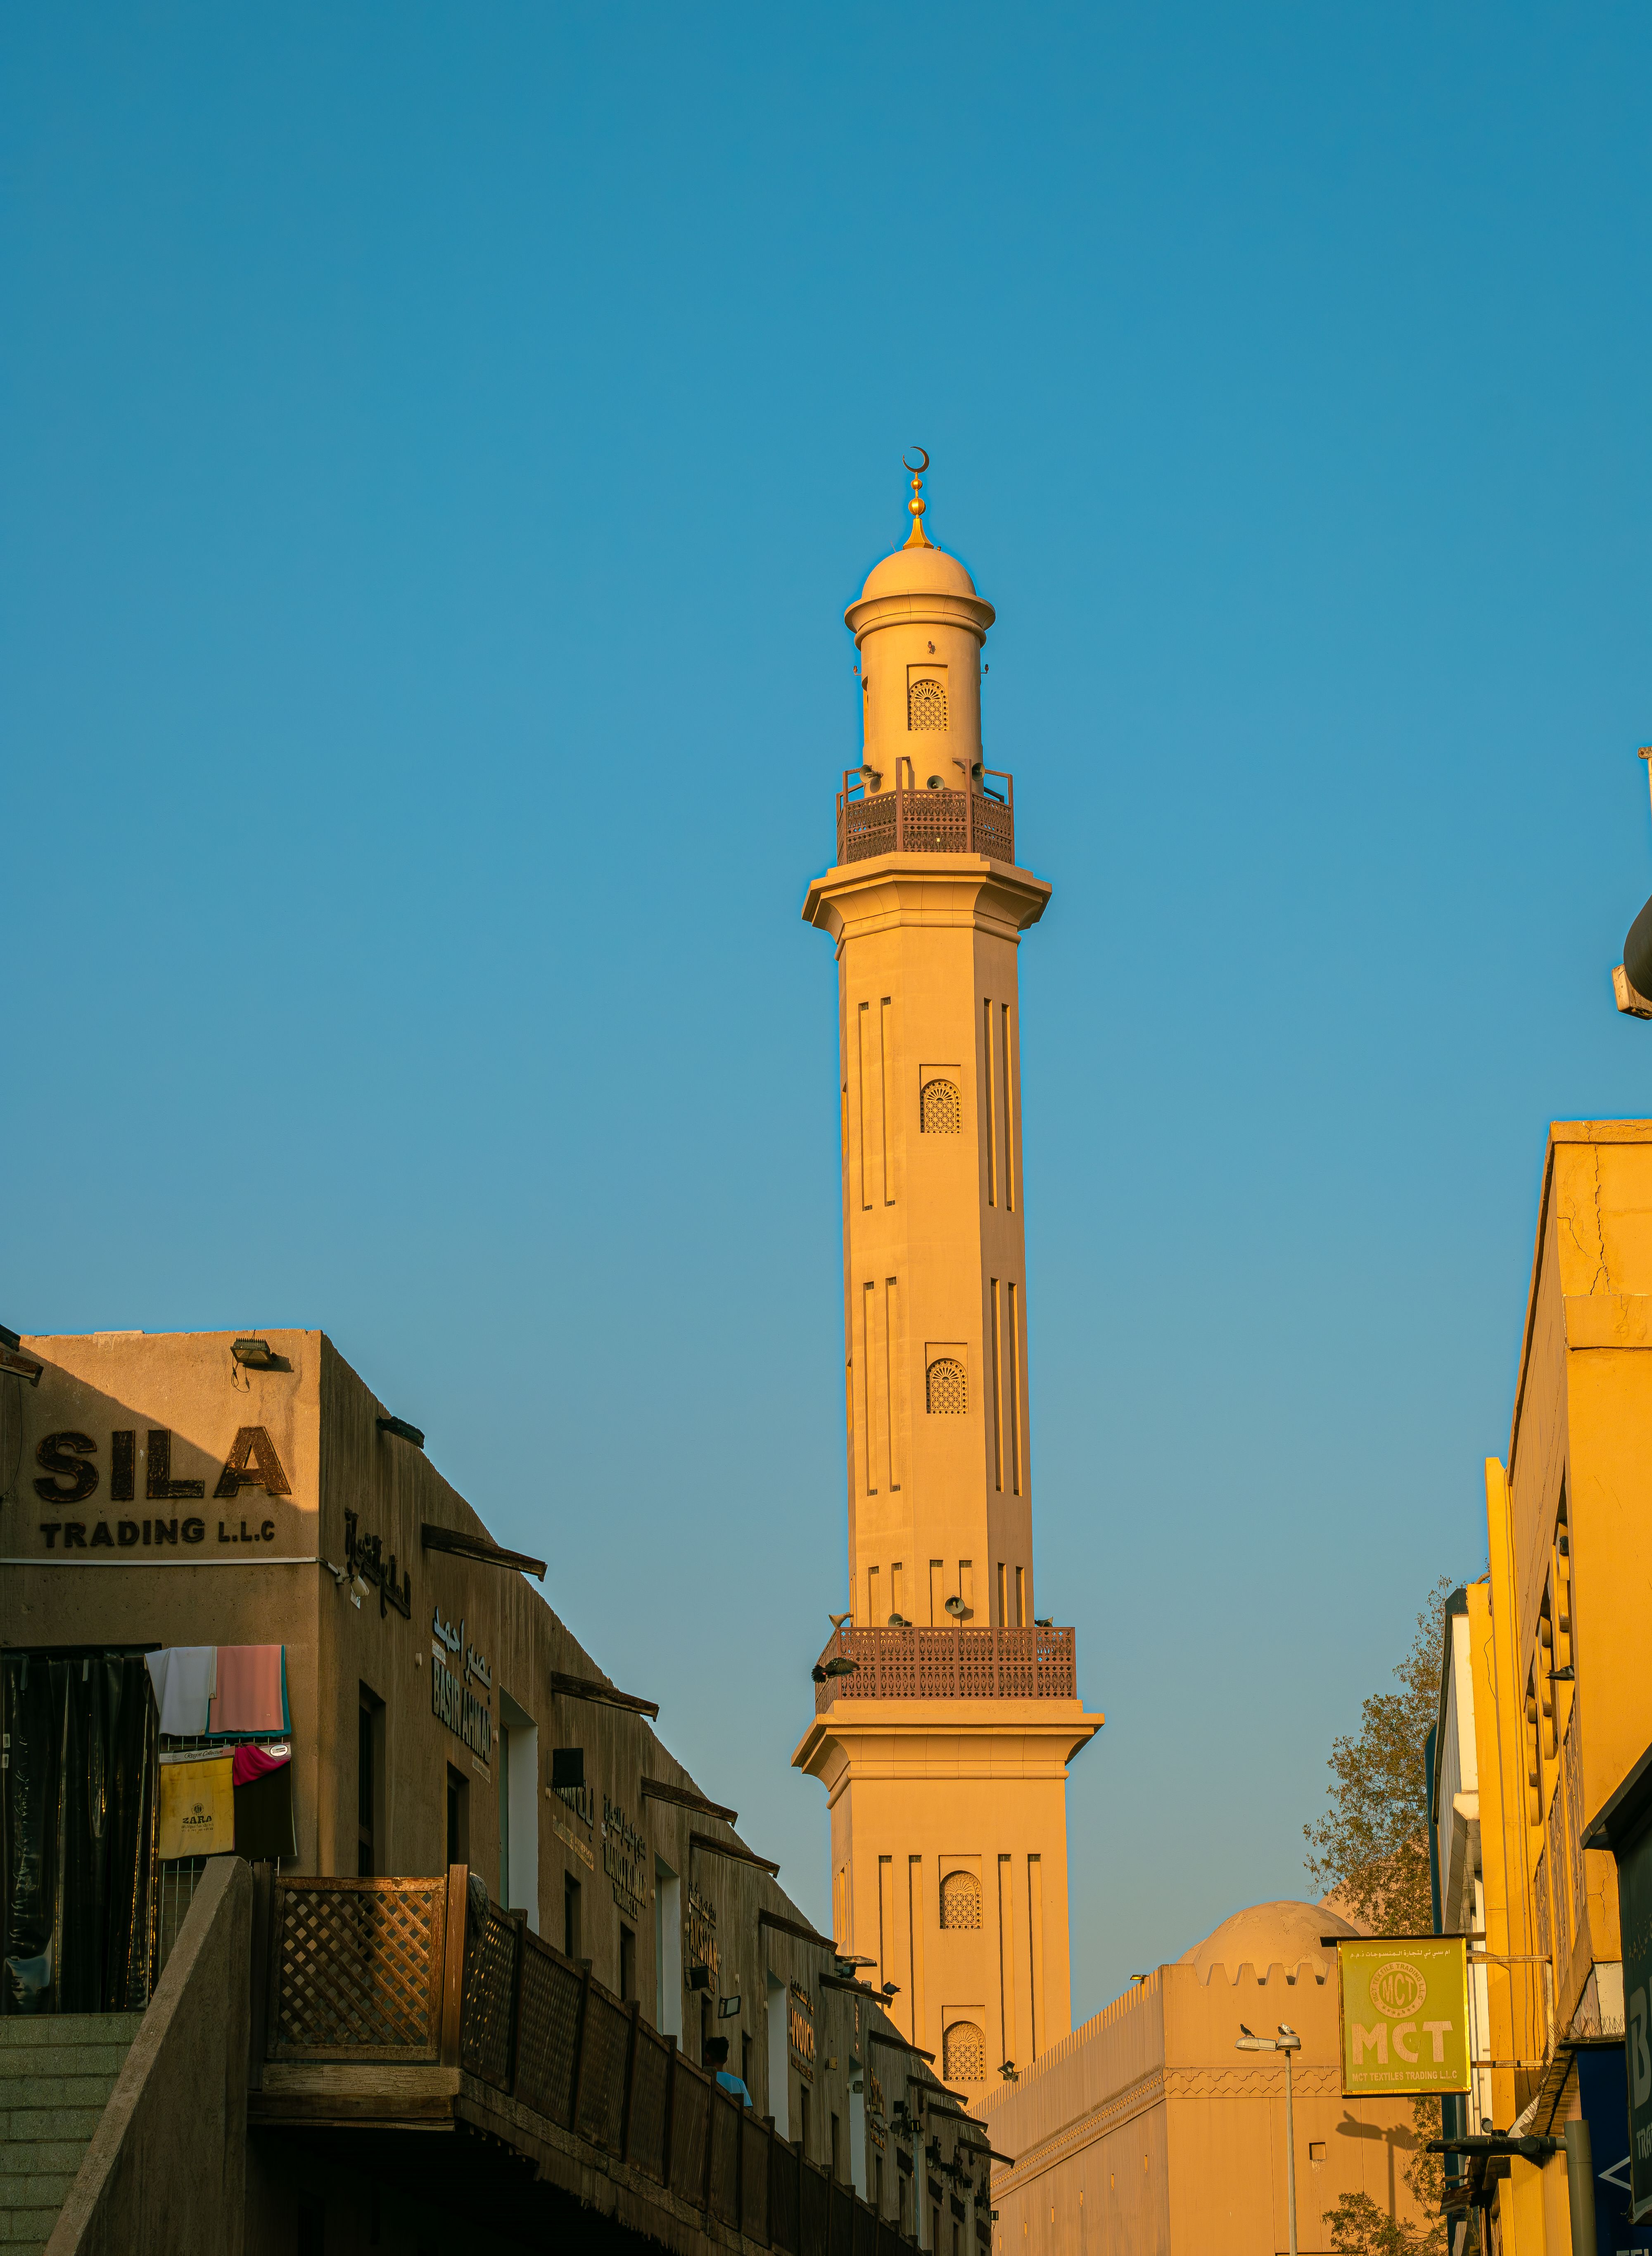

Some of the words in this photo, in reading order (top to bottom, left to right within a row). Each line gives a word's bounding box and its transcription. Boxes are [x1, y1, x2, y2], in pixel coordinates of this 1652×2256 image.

[33, 1426, 292, 1502] SILA
[40, 1517, 204, 1548] TRADING
[218, 1520, 275, 1542] L.L.C
[432, 1657, 460, 1736] BASIR
[460, 1687, 492, 1765] AHMAD
[182, 1815, 212, 1824] ZARA
[625, 1859, 647, 1909] KUMAR
[689, 1915, 718, 1976] AKSHAR
[1424, 1949, 1431, 1959] تي
[1432, 1950, 1444, 1959] سي
[1373, 1964, 1394, 1985] TEXTILE
[1396, 1964, 1422, 1982] TRADING
[1382, 1973, 1414, 2006] MCT
[1351, 2021, 1453, 2065] MCT
[1630, 1975, 1652, 2110] B
[1352, 2073, 1368, 2082] MCT
[1369, 2071, 1404, 2081] TEXTILES
[1405, 2070, 1438, 2080] TRADING
[1439, 2069, 1457, 2079] L.L.C
